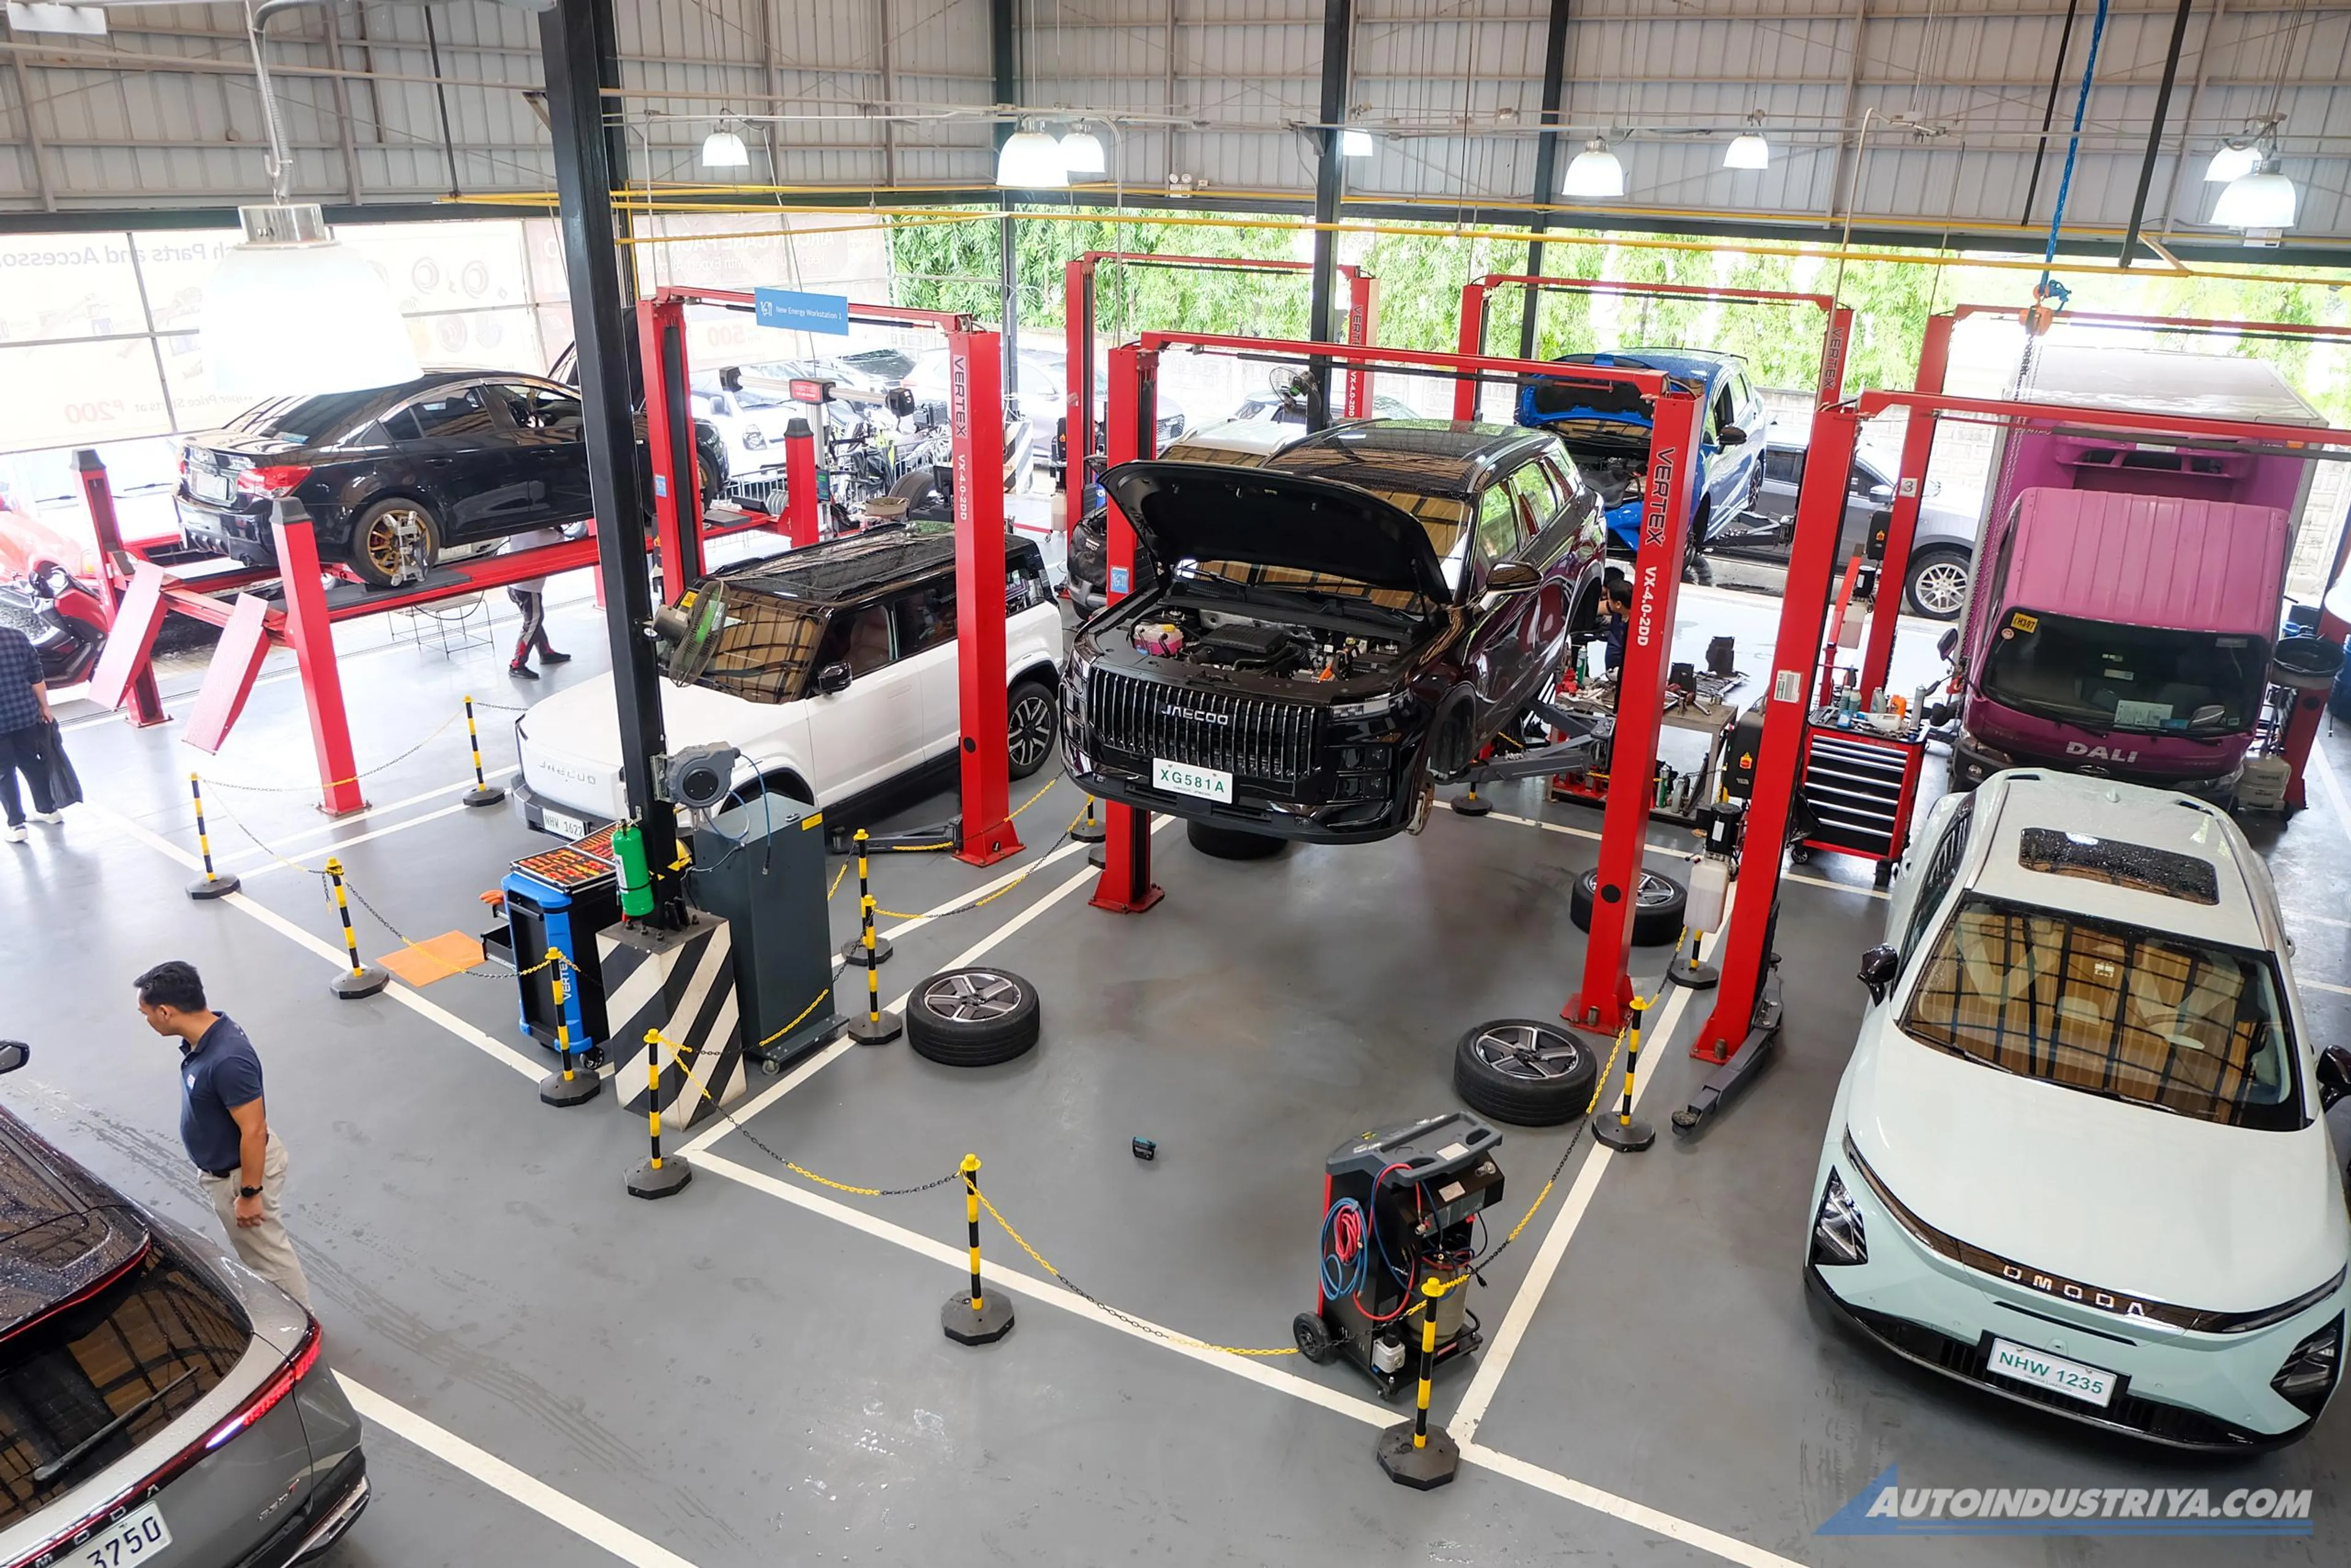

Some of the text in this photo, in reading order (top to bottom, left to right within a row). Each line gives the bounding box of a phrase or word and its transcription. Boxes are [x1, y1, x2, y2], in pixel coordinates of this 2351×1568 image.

[789, 307, 805, 317] Energy
[806, 309, 838, 318] Workstation
[1823, 327, 1843, 389] VERTEX
[954, 356, 967, 437] VERTEX
[1349, 371, 1357, 416] VX-4.0-2DD
[958, 454, 967, 520] VX-4.0-2DD
[1645, 447, 1675, 547] VERTEX
[1903, 481, 1913, 492] 3
[1637, 566, 1657, 647] VX-4.0-2DD
[1161, 705, 1228, 726] JAECOO
[2066, 741, 2138, 763] DALI
[1161, 769, 1224, 793] XG581A
[544, 814, 583, 837] NHW 1622
[2003, 1265, 2145, 1316] OMODA
[1999, 1351, 2104, 1394] NHW 1235
[87, 1516, 162, 1568] 3750
